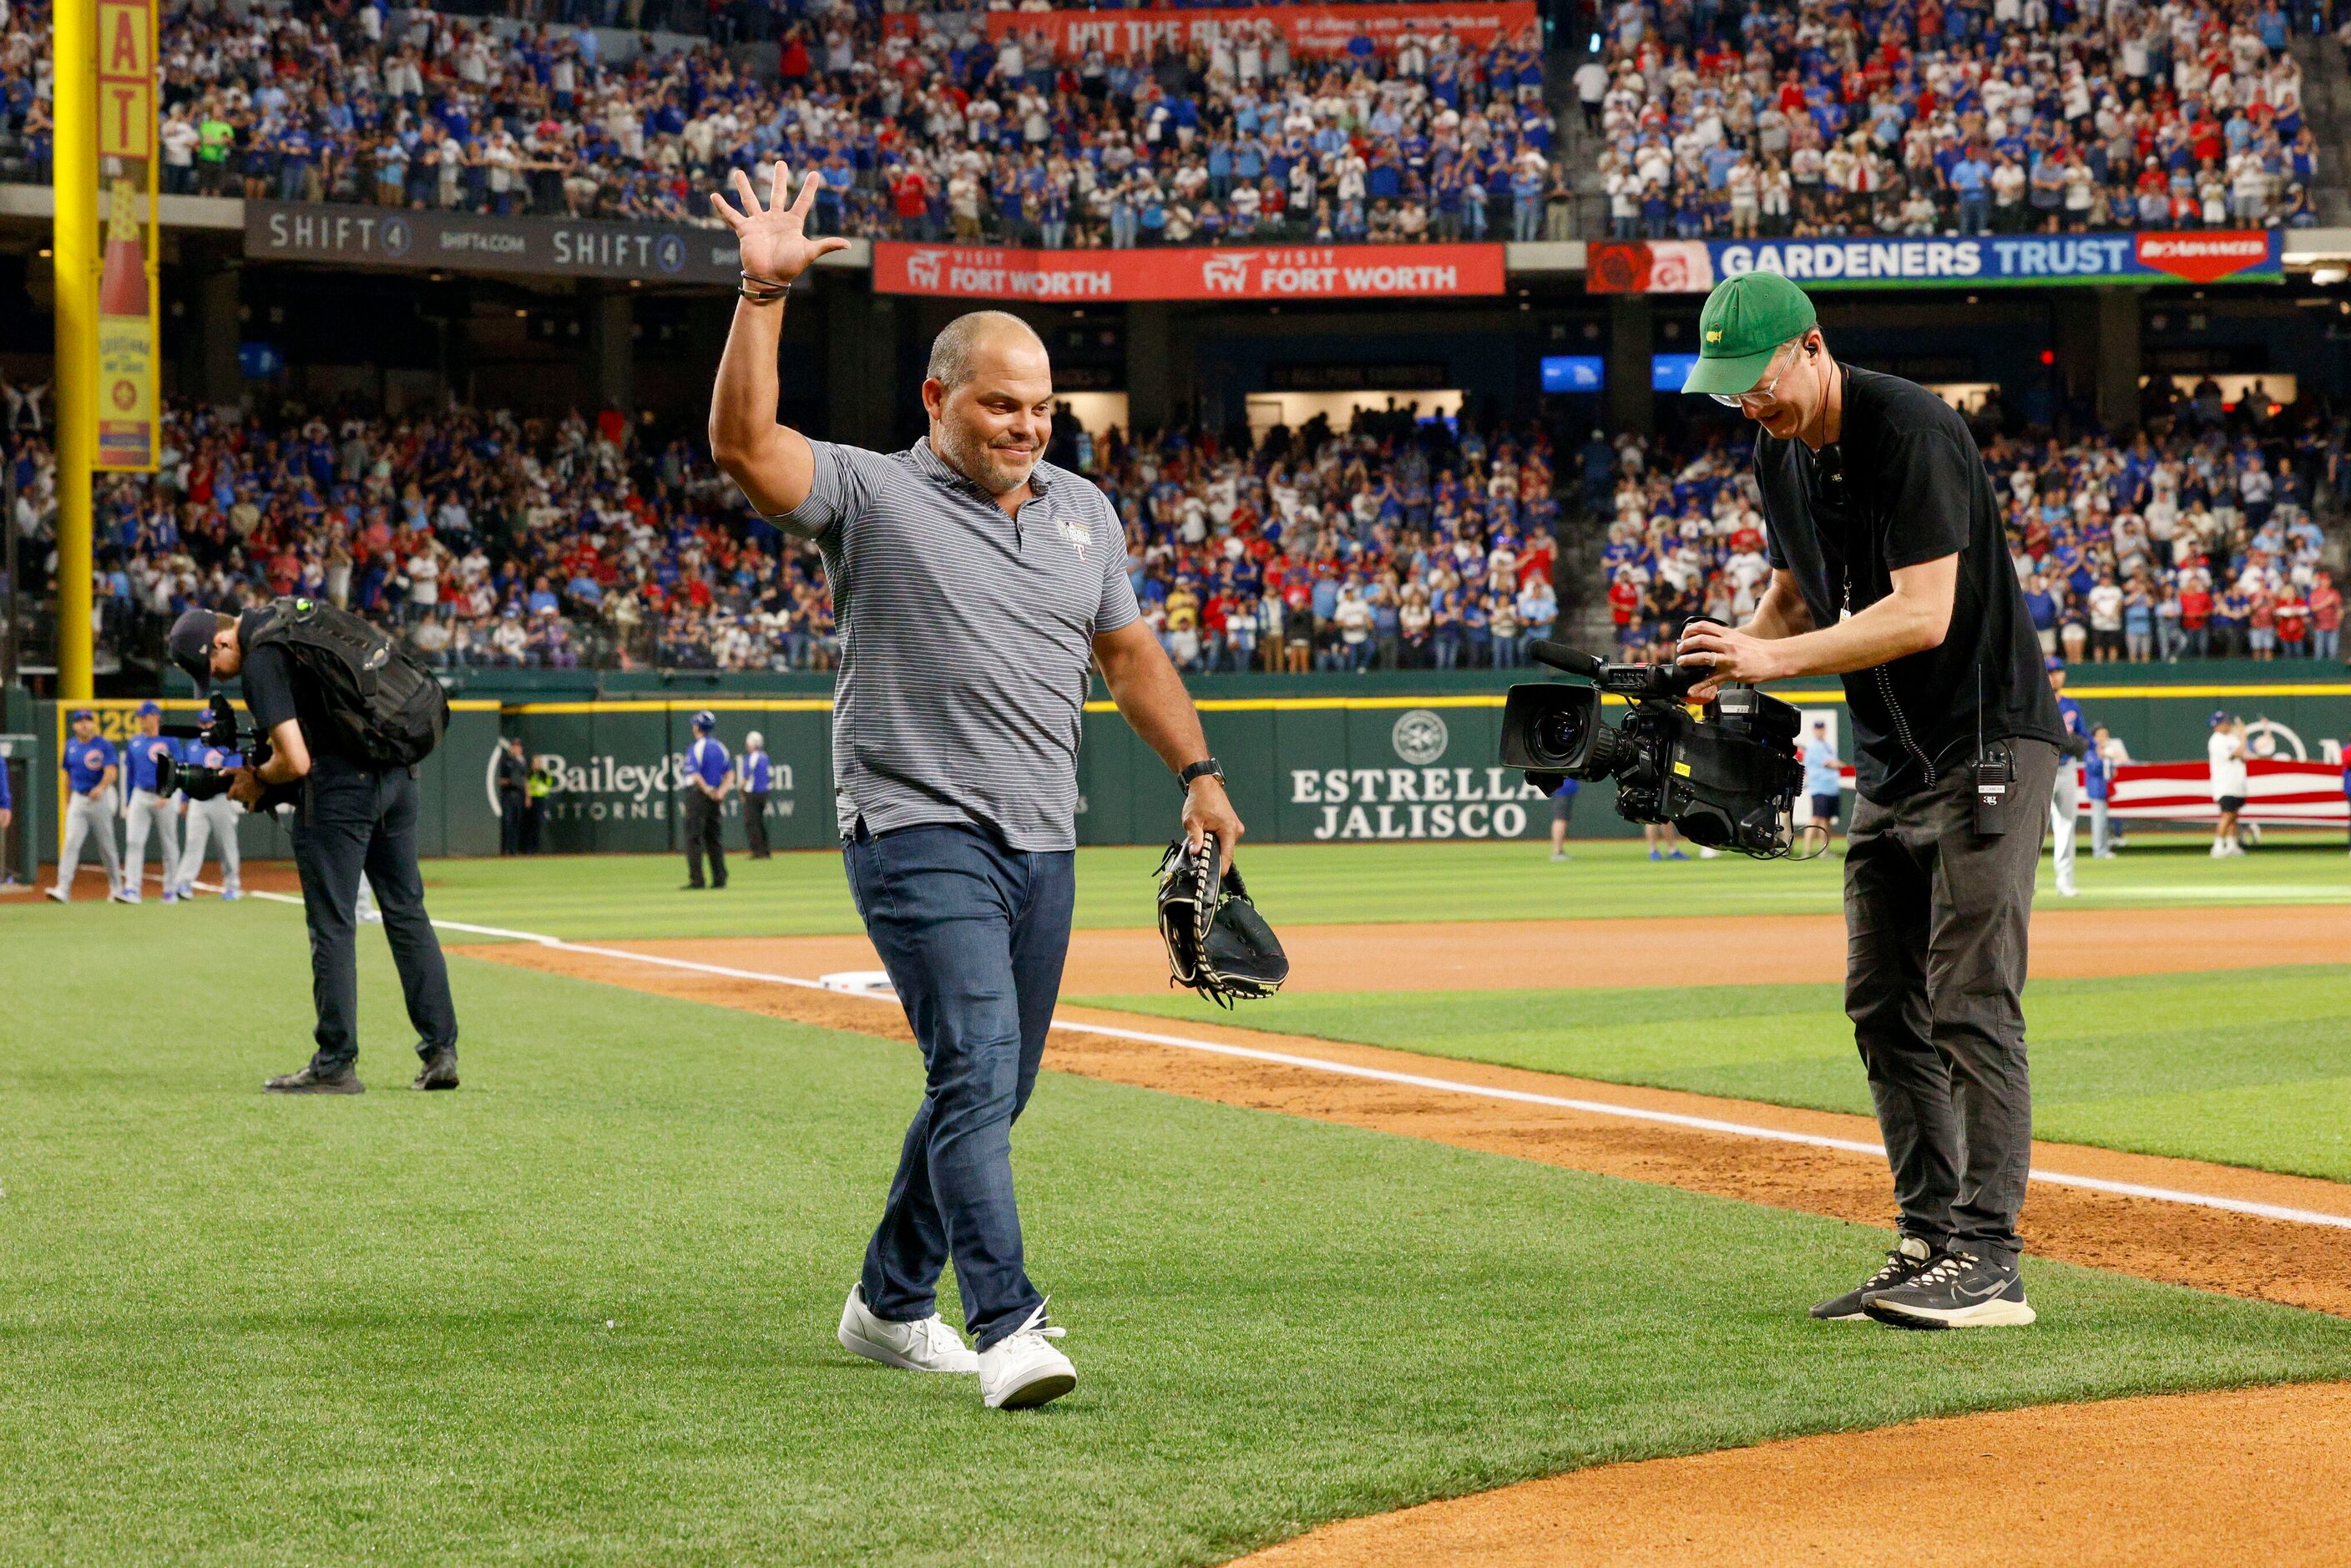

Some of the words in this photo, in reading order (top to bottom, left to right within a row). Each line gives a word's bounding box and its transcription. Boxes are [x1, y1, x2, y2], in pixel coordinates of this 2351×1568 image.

[1068, 21, 1120, 54] HIT
[1125, 20, 1183, 53] THE
[270, 213, 375, 252] SHIFT
[385, 224, 402, 246] 4
[553, 234, 652, 269] SHIFT
[662, 241, 679, 266] 4
[952, 251, 1004, 265] VISIT
[1266, 251, 1335, 266] VISIT
[1722, 241, 1980, 278] GARDENERS
[1994, 238, 2129, 274] TRUST
[949, 267, 1004, 292] FORT
[1008, 271, 1112, 296] WORTH
[1261, 268, 1338, 292] FORT
[1344, 266, 1457, 291] WORTH
[538, 753, 657, 802] Bailey
[1313, 802, 1528, 840] JALISCO
